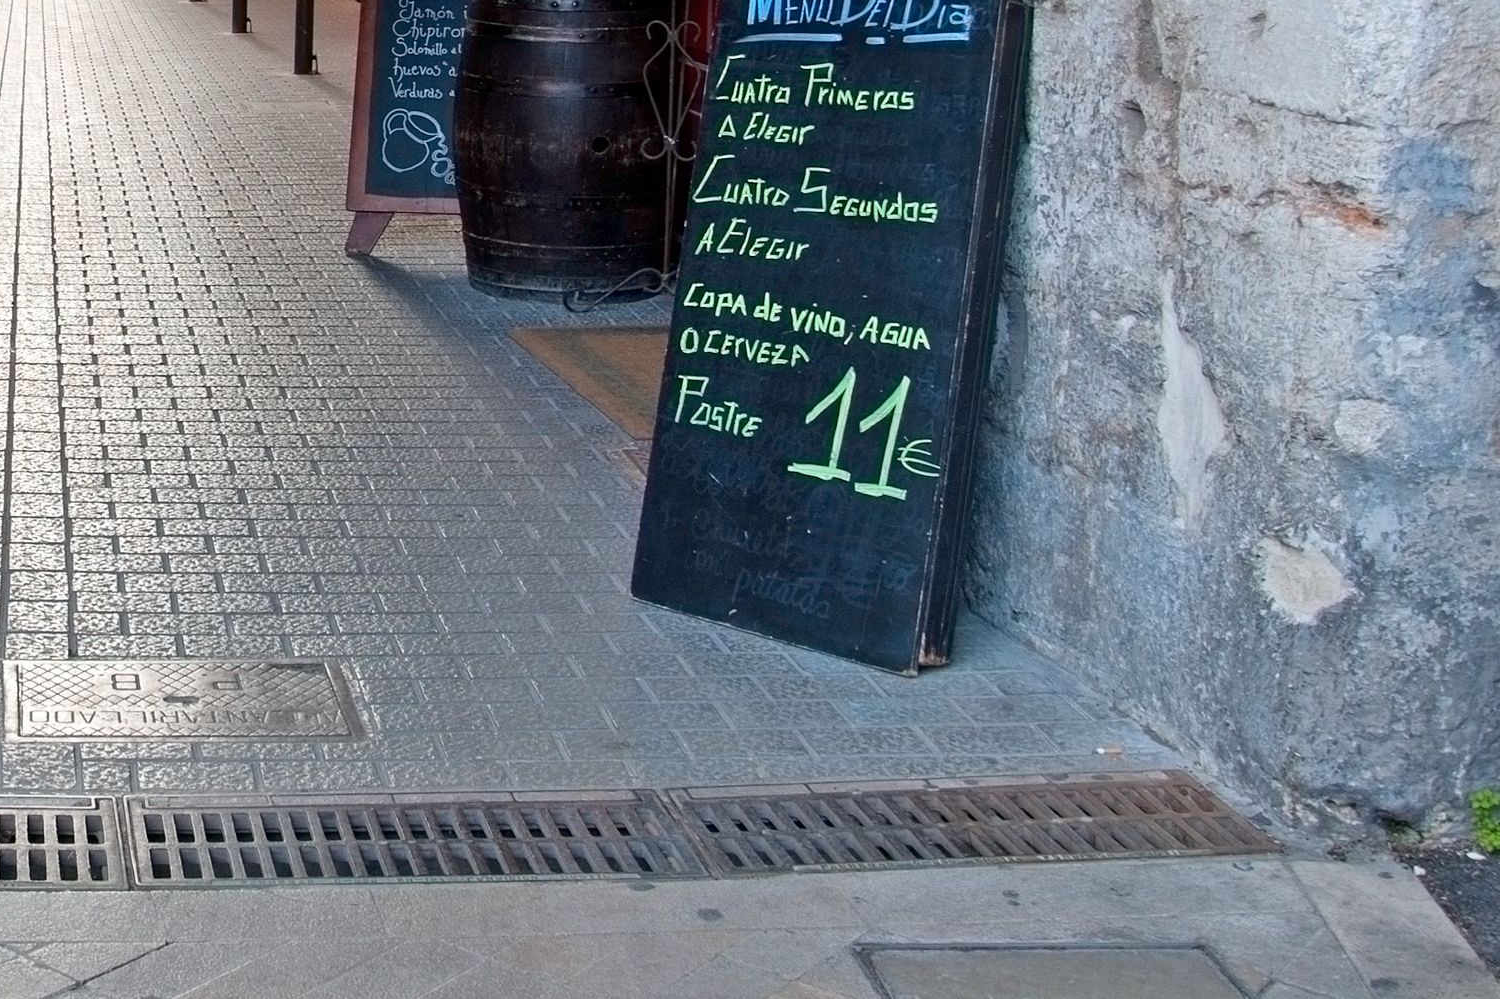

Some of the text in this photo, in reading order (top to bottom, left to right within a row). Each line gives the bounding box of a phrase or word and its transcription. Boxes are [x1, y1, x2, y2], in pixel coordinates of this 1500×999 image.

[399, 1, 456, 21] Jamón
[391, 37, 448, 57] Solomillo
[387, 77, 443, 99] Verduras
[718, 115, 736, 139] A
[695, 228, 714, 256] A
[683, 282, 748, 316] COPA
[859, 315, 931, 351] AGUA
[679, 327, 699, 354] O
